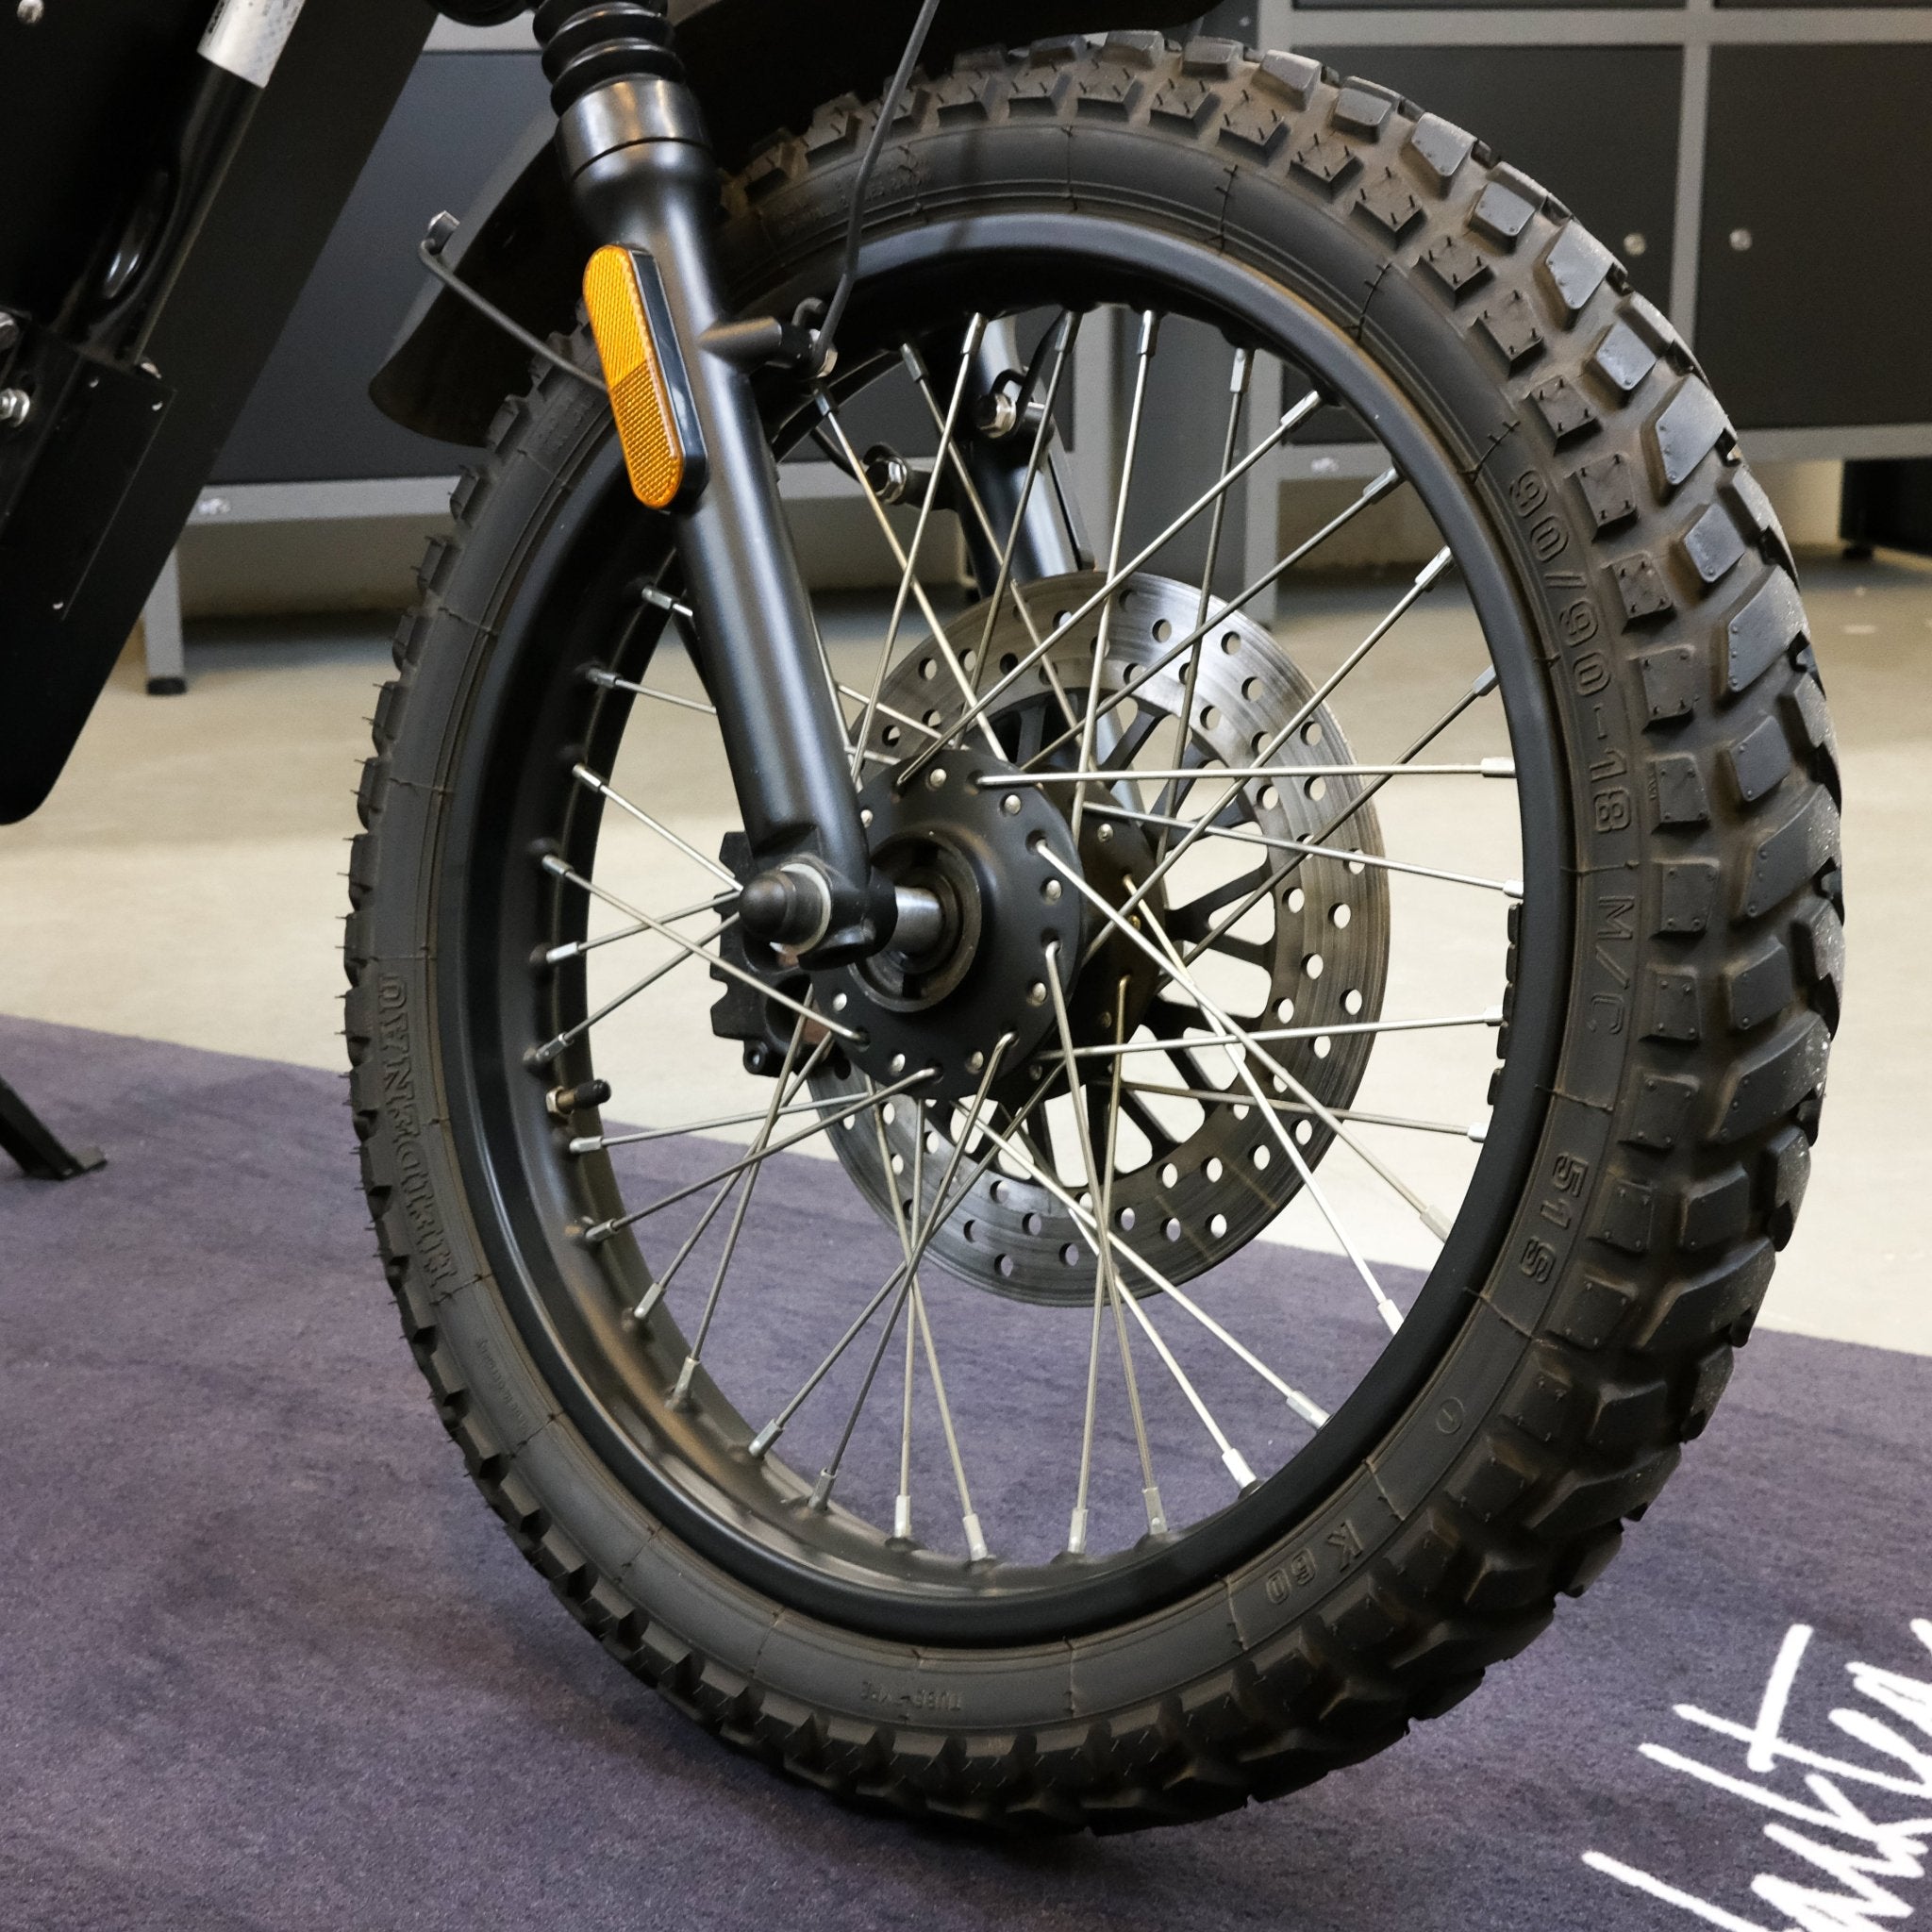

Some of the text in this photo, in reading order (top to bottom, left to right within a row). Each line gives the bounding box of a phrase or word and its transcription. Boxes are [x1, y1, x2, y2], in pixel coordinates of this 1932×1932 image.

[1586, 895, 1635, 1036] M/C
[377, 974, 458, 1289] HEIDENAU
[1264, 1520, 1365, 1606] K 60
